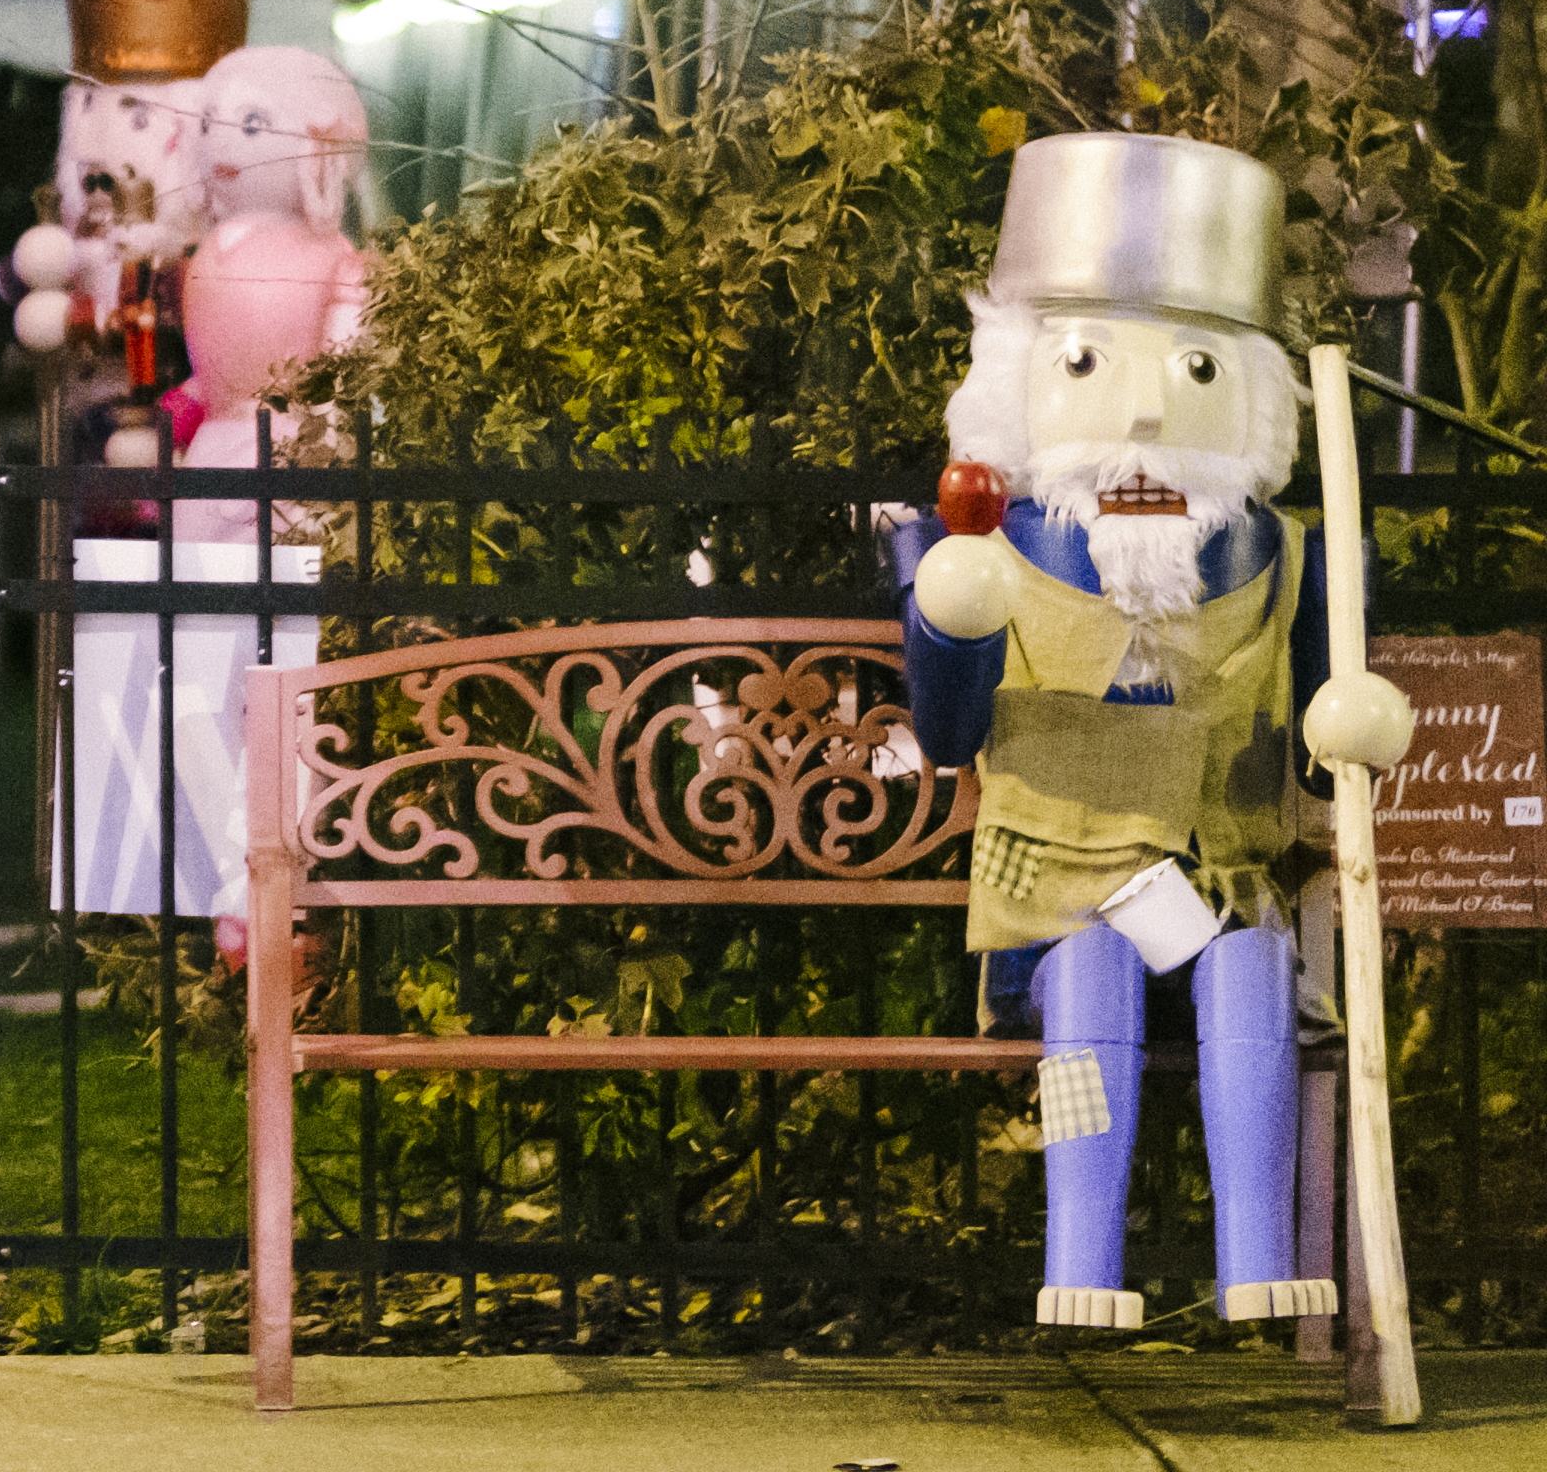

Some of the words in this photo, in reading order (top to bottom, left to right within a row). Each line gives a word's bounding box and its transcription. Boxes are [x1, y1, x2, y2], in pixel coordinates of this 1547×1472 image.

[1406, 695, 1502, 759] nny
[1371, 750, 1537, 809] ppleseed
[1376, 805, 1465, 826] ponsored
[1470, 805, 1492, 825] by
[1511, 805, 1537, 819] 170
[1438, 847, 1516, 863] Historical
[1388, 872, 1418, 887] and
[1420, 871, 1477, 888] Culture
[1399, 895, 1462, 912] Michael
